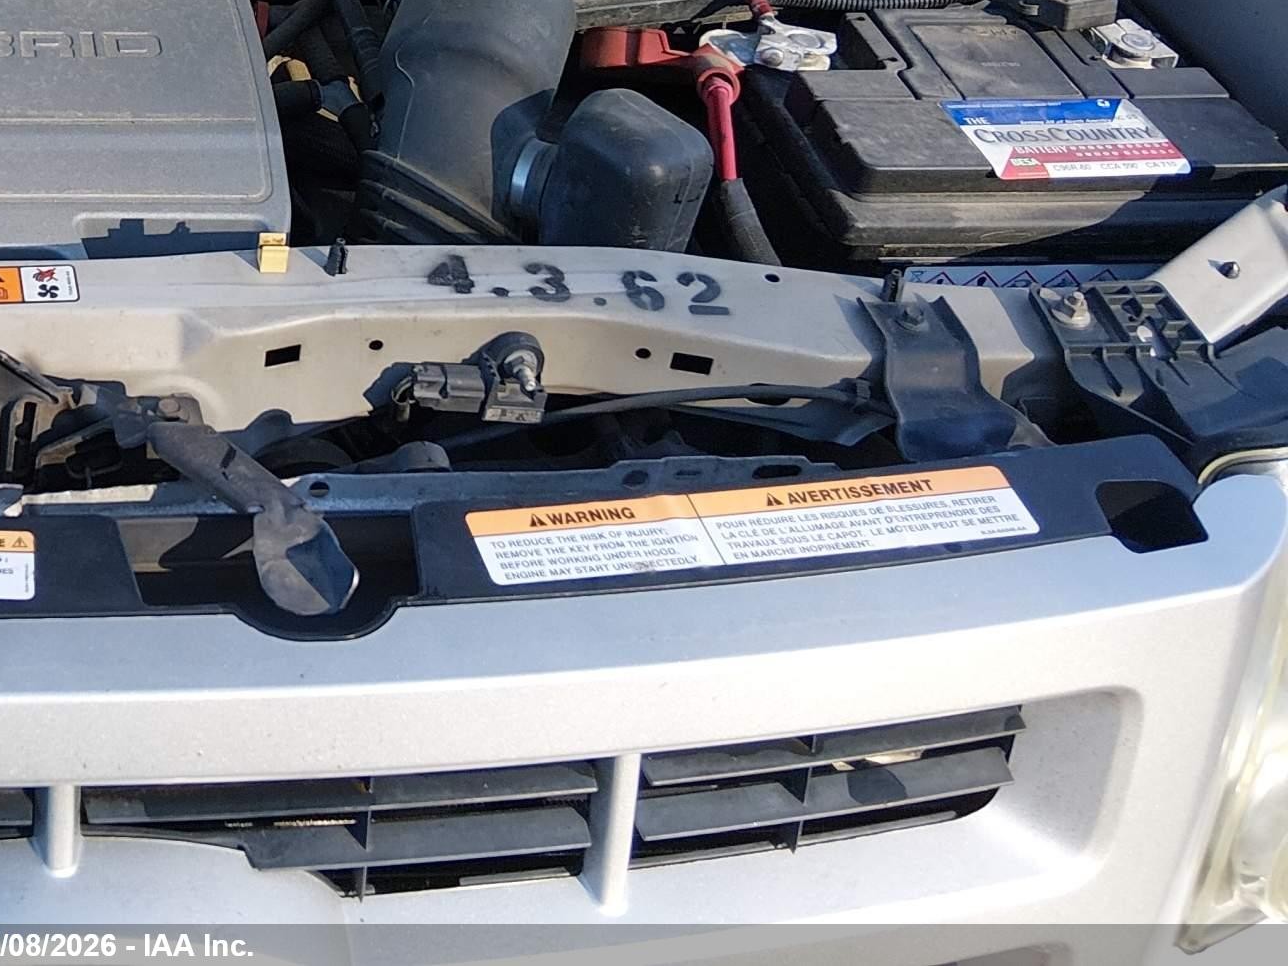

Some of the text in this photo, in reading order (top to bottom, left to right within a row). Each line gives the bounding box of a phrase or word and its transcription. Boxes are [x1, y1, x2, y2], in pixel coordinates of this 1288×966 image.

[1015, 145, 1068, 154] BATTERY
[787, 479, 934, 504] AVERTISSEMENT
[546, 507, 635, 525] WARNING
[715, 521, 746, 529] POUR
[797, 513, 819, 521] LES
[820, 509, 868, 518] RISQUES
[869, 506, 884, 515] DE
[951, 495, 997, 506] RETIRER
[720, 531, 736, 540] LA
[761, 527, 777, 535] DE
[850, 517, 882, 526] AVANT
[978, 505, 1001, 514] DES
[726, 538, 778, 549] TRAVAUX
[780, 535, 809, 544] SOUS
[810, 533, 825, 541] LE
[870, 528, 885, 536] LE
[886, 523, 930, 533] MOTEUR
[932, 520, 959, 530] PEUT
[977, 514, 1020, 524] METTRE
[490, 541, 505, 549] TO
[508, 537, 553, 548] REDUCE
[555, 535, 577, 543] THE
[580, 532, 606, 541] RISK
[608, 530, 622, 538] OF
[495, 549, 542, 559] REMOVE
[545, 546, 566, 554] THE
[568, 544, 590, 553] KEY
[628, 539, 648, 547] THE
[651, 534, 698, 546] IGNITION
[500, 559, 545, 570] BEFORE
[547, 554, 601, 565] WORKING
[603, 550, 642, 561] UNDER
[732, 552, 749, 560] EN
[750, 547, 797, 558] MARCHE
[505, 569, 545, 580] ENGINE
[549, 566, 572, 576] MAY
[574, 564, 609, 574] START
